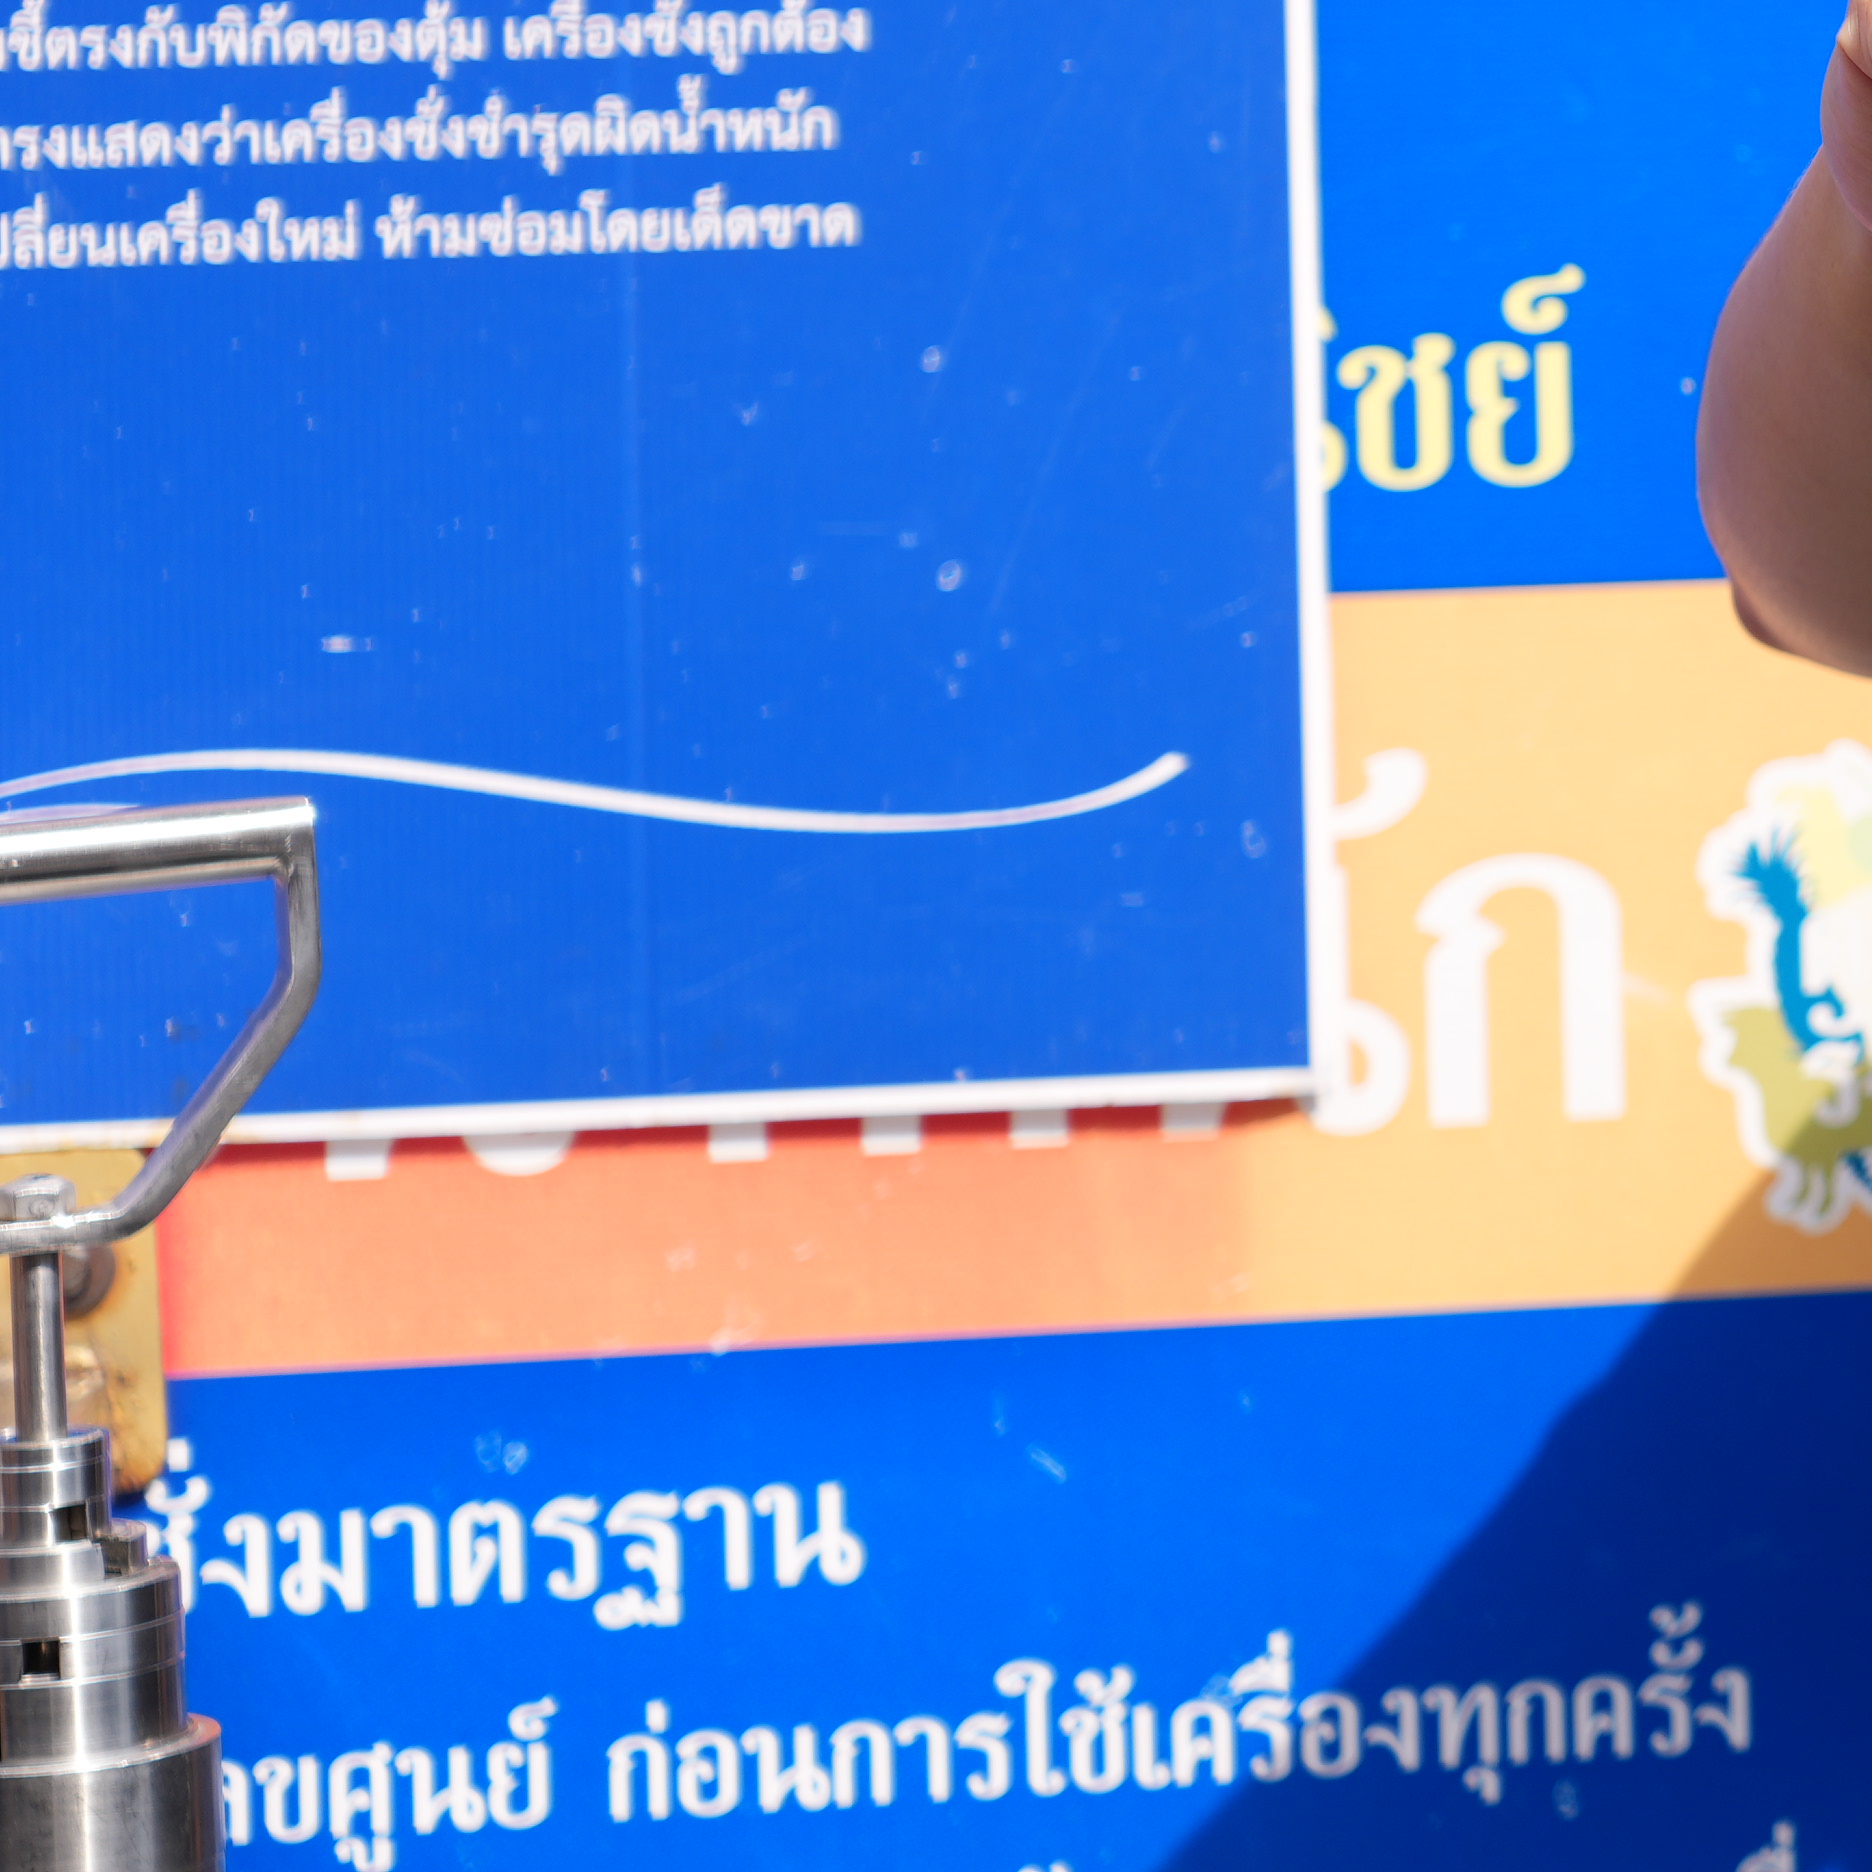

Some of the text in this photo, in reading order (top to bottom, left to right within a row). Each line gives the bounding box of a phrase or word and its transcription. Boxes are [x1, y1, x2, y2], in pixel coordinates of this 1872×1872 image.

[0, 74, 838, 175] รงแสดงว่าเครื่องชั่งชำรุดผิดน้ำหนัก
[0, 183, 861, 269] ลี่ยนเครื่องใหม่ ห้ามซ่อมโดยเด็ดขาด
[1320, 262, 1586, 493] ชย์
[605, 1602, 1752, 1823] ก่อนการใช้เครื่องทุกครั้ง
